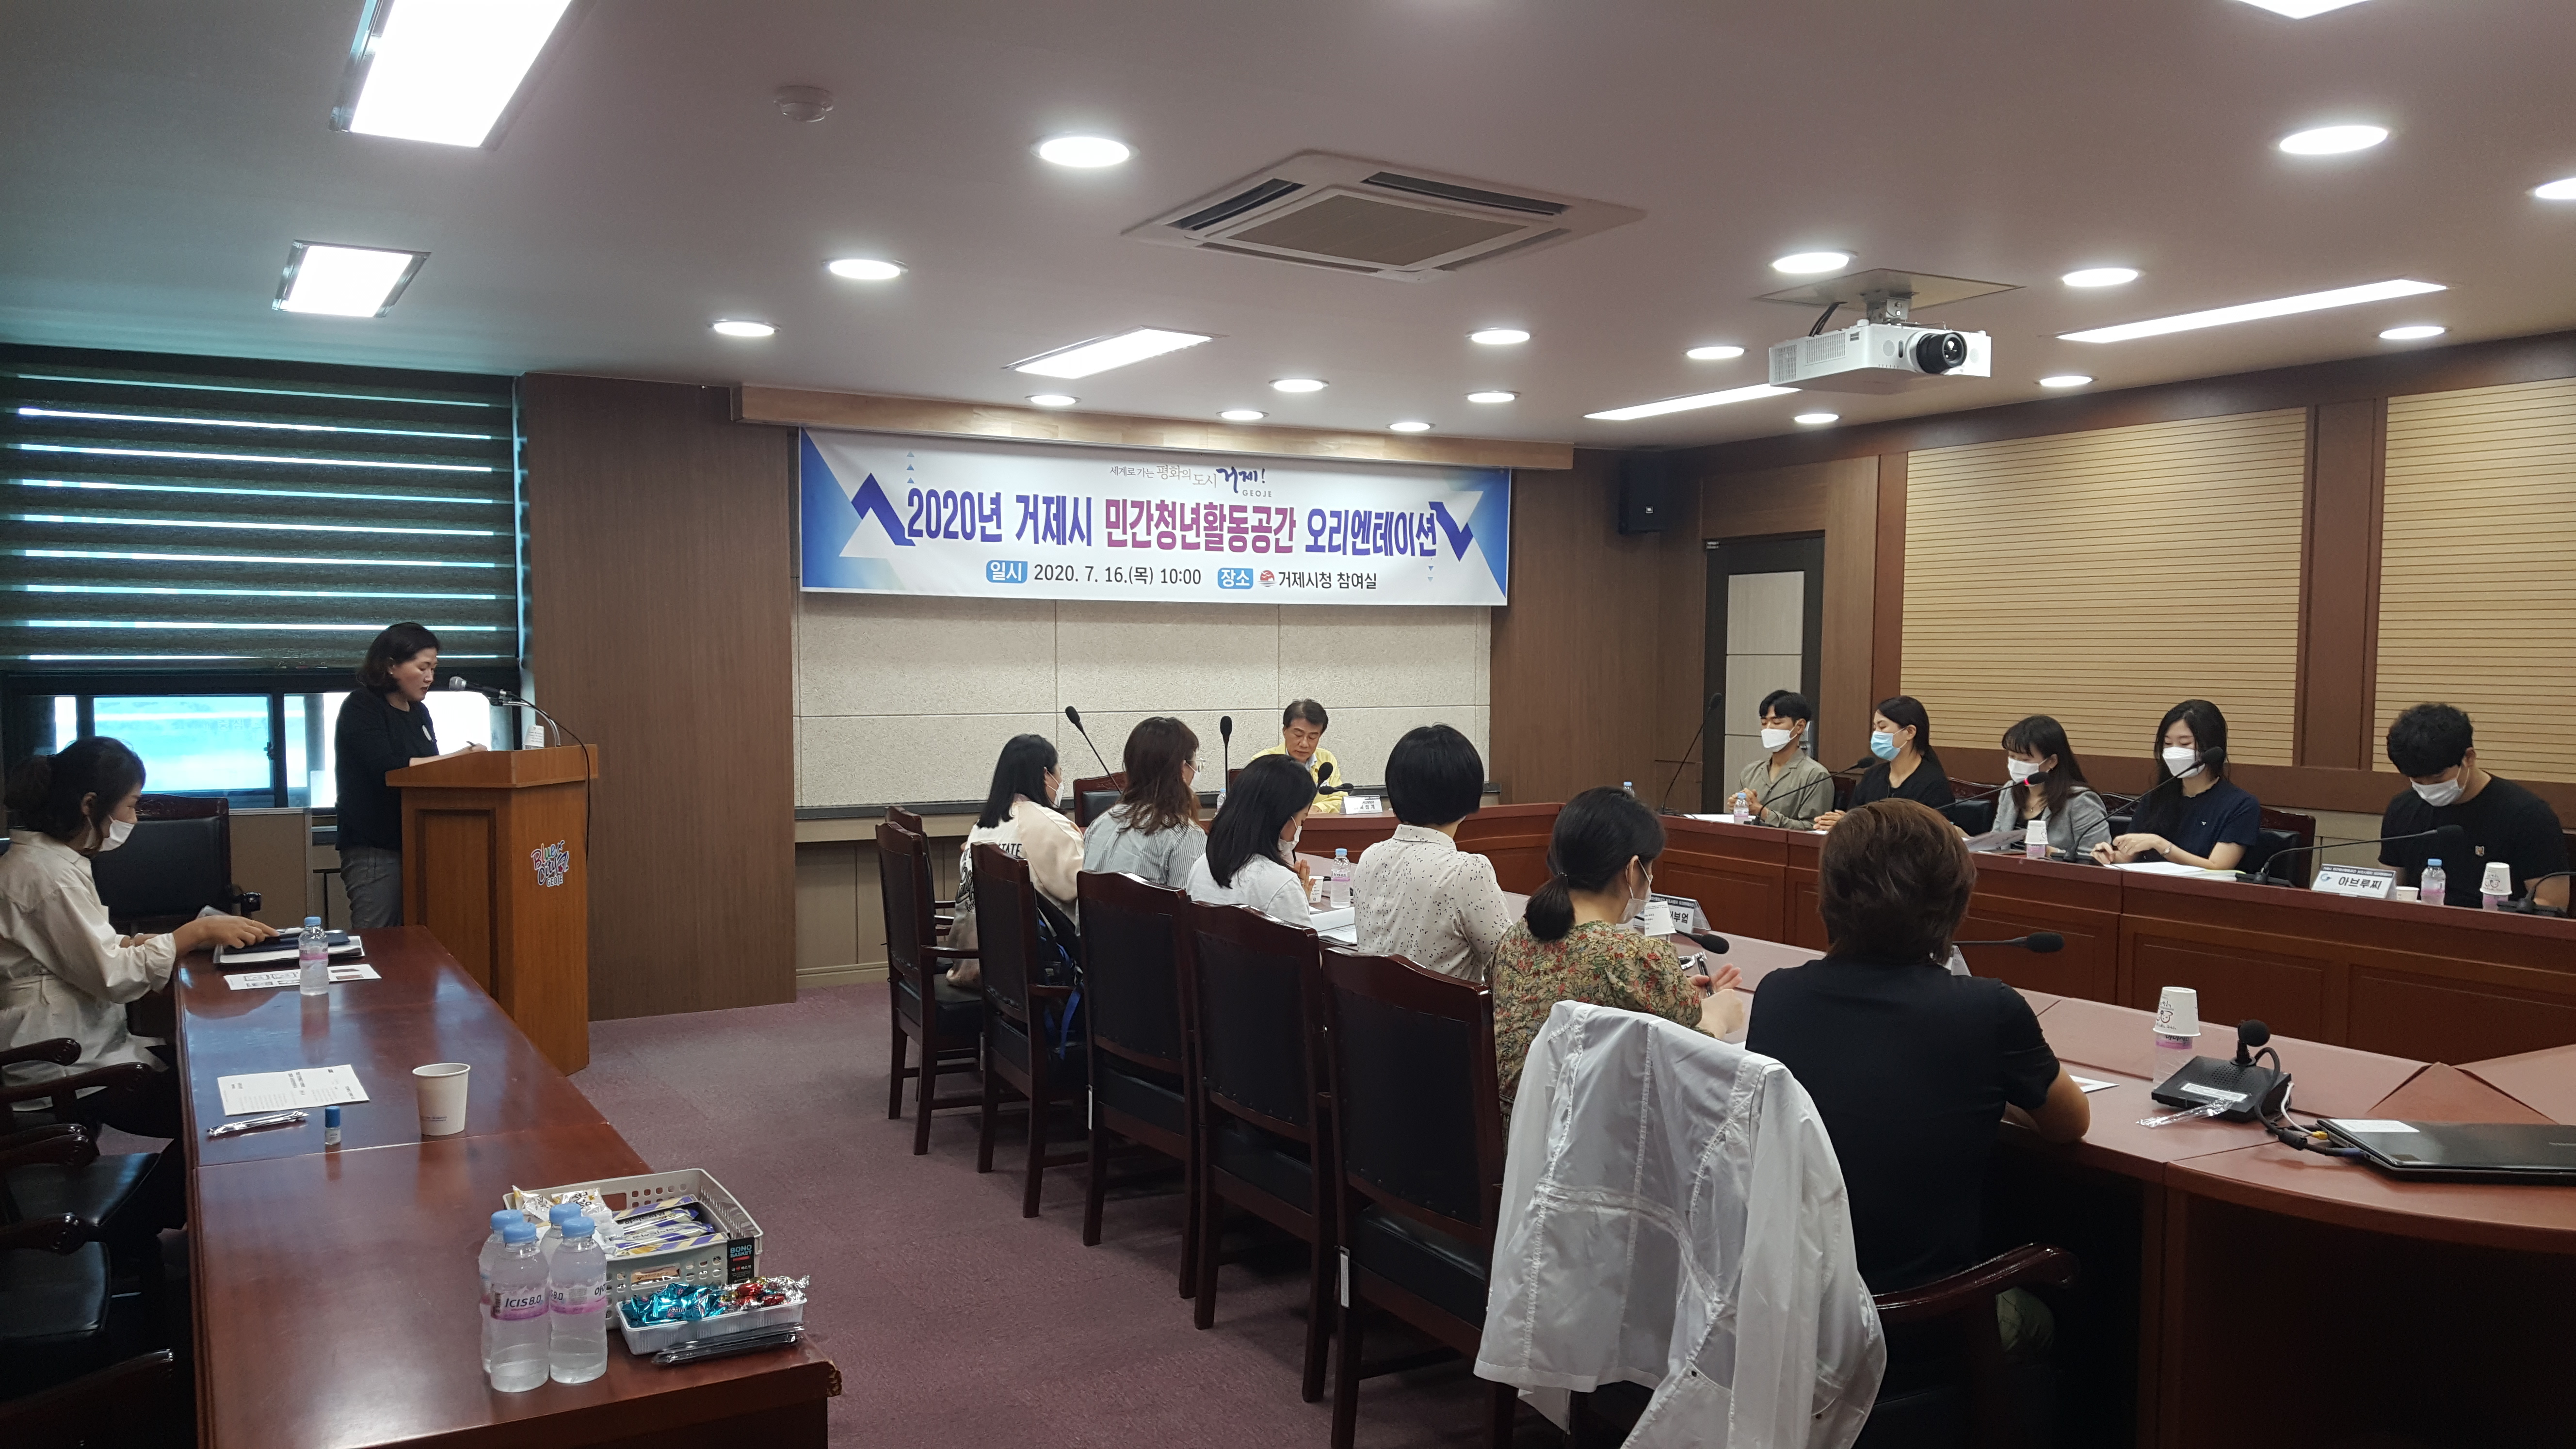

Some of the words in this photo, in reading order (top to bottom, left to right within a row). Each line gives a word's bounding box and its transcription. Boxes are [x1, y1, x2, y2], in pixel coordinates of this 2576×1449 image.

[1110, 466, 1136, 477] 세계로
[1137, 467, 1154, 479] 가는
[1157, 464, 1191, 480] 평화의
[1192, 473, 1217, 488] 도시
[1242, 489, 1272, 498] GEOJE
[907, 487, 1002, 542] 2020년
[1015, 494, 1092, 547] 거제시
[1105, 499, 1296, 554] 민간청년활동공간
[1305, 508, 1437, 557] 오리엔테이션
[990, 561, 1022, 581] 일시
[1034, 564, 1079, 582] 2020.
[1084, 565, 1098, 582] 7.
[1105, 566, 1154, 585] 16.(목)
[1160, 568, 1201, 585] 10:00
[1221, 569, 1250, 587] 장소
[1278, 571, 1332, 589] 거제시청
[1337, 572, 1377, 589] 참여실
[531, 843, 557, 870] Blue
[999, 843, 1022, 857] TATE
[730, 1244, 752, 1254] BONO
[730, 1250, 752, 1258] BASKET
